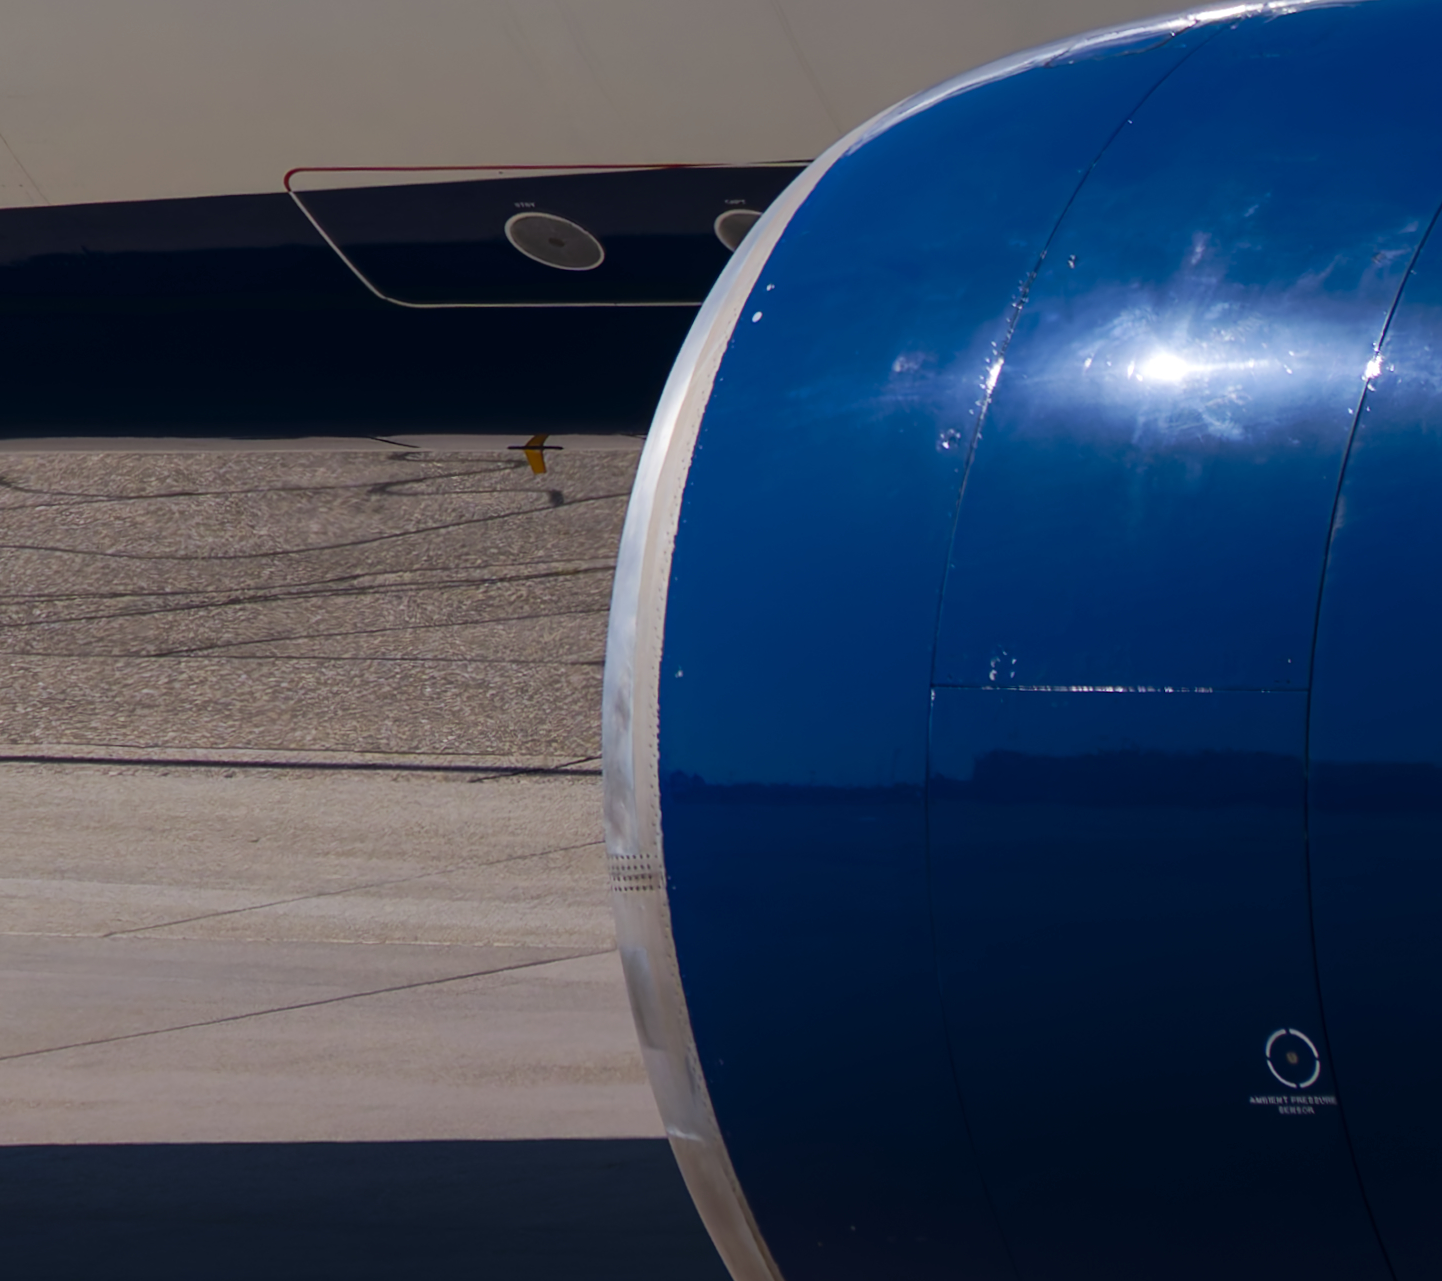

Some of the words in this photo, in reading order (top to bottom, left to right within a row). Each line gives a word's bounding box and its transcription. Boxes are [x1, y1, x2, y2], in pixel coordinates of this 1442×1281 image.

[1250, 1096, 1288, 1104] AMBIENT
[1291, 1096, 1337, 1105] PRESSURE
[1279, 1106, 1315, 1115] SENSOR
